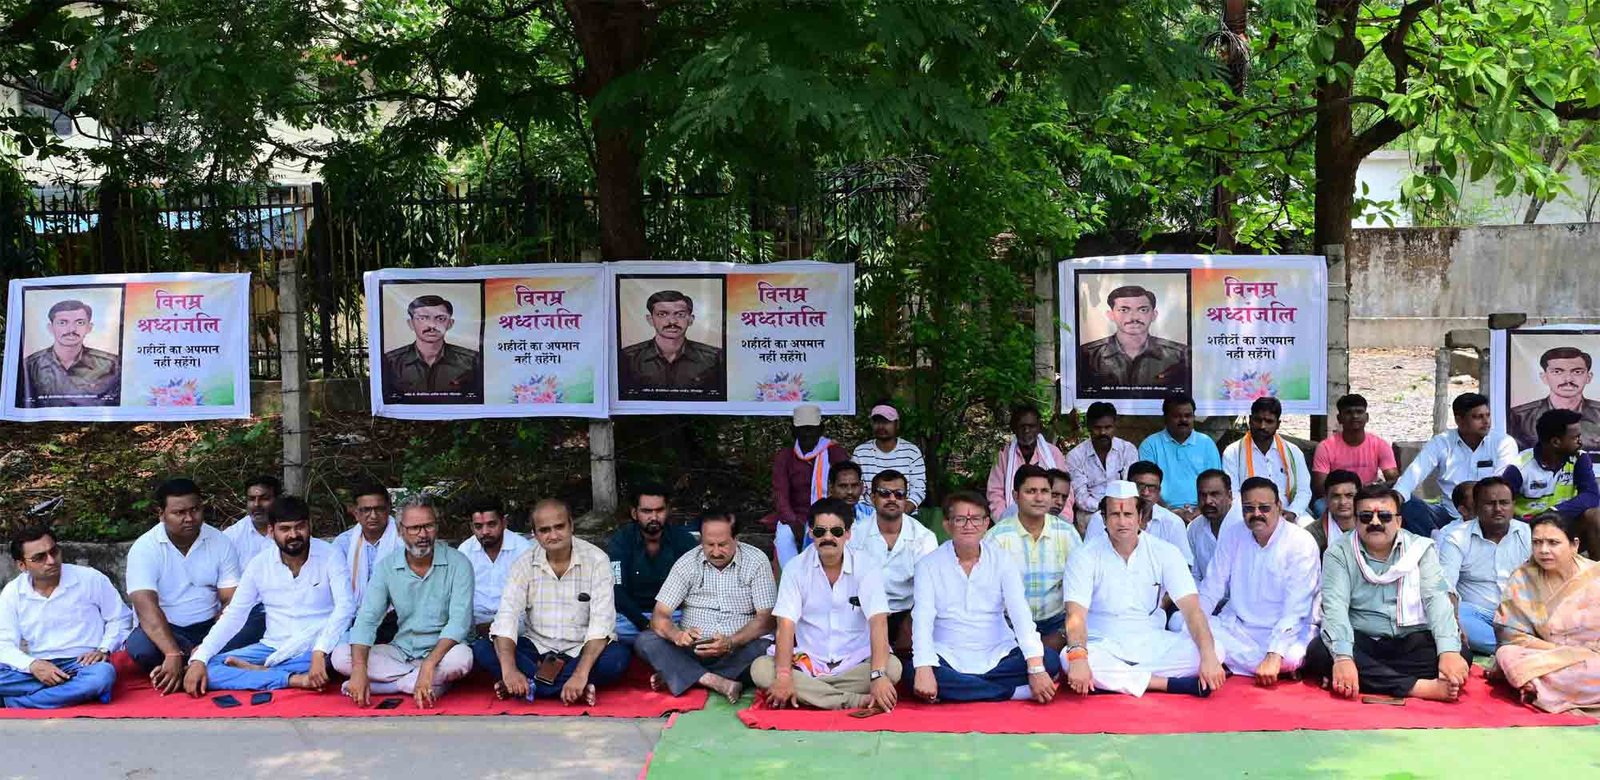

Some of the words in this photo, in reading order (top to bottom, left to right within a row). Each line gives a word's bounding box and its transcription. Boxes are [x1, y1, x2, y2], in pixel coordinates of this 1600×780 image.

[757, 281, 809, 303] विनम्र
[1224, 277, 1278, 299] विनम्र
[156, 290, 204, 310] विनम्र
[515, 285, 566, 306] विनम्र
[497, 339, 527, 352] शहीदों
[529, 342, 543, 351] का
[545, 341, 580, 351] अपमान
[741, 336, 771, 350] शहीदों
[774, 339, 788, 349] का
[790, 338, 825, 349] अपमान
[1207, 333, 1239, 347] शहीदों
[1242, 335, 1257, 345] का
[1259, 335, 1296, 346] अपमान
[137, 343, 165, 355] शहीदों
[168, 345, 184, 355] का
[185, 344, 220, 355] अपमान
[758, 349, 776, 363] नहीं
[1226, 346, 1244, 361] नहीं
[153, 356, 171, 368] नहीं
[514, 352, 532, 365] नहीं
